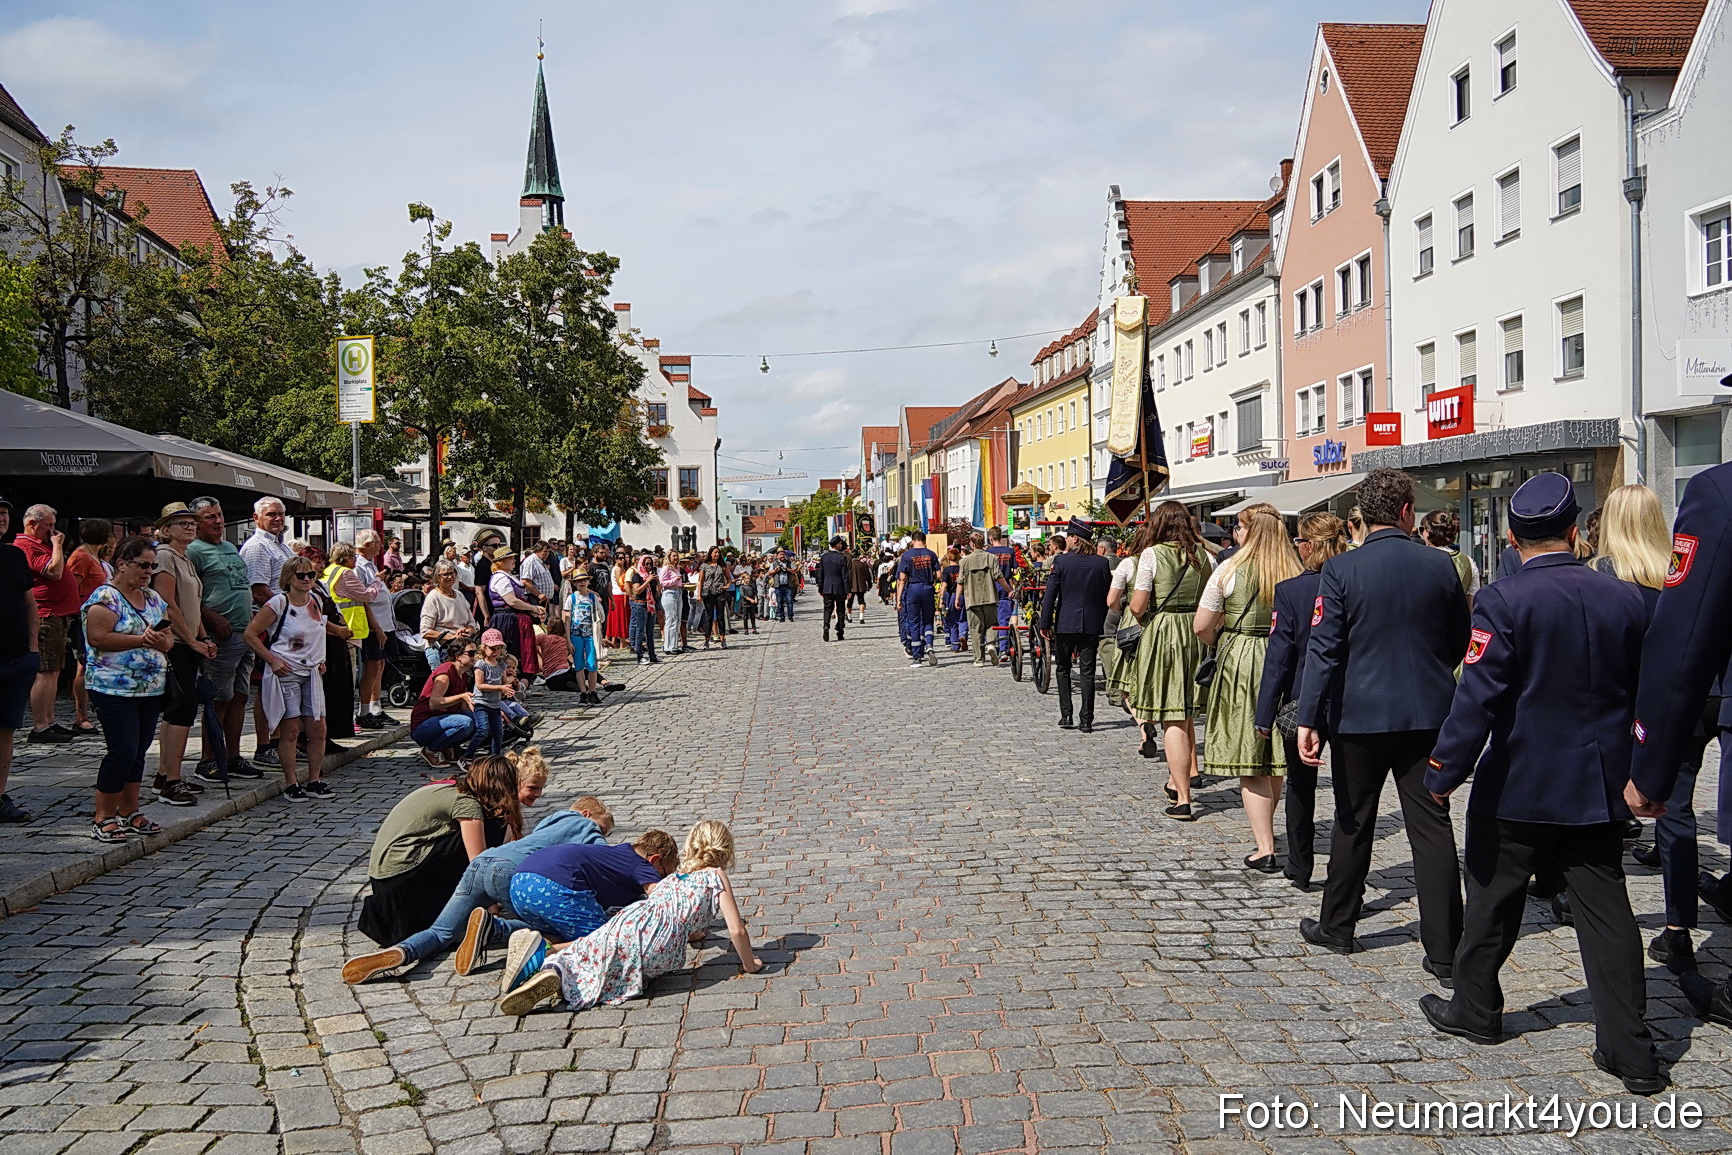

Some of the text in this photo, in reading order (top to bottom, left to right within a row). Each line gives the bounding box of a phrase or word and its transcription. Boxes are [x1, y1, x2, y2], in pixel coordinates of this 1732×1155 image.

[1685, 357, 1727, 374] Mittendrin
[1428, 395, 1460, 423] WITT
[1373, 423, 1397, 432] WITT
